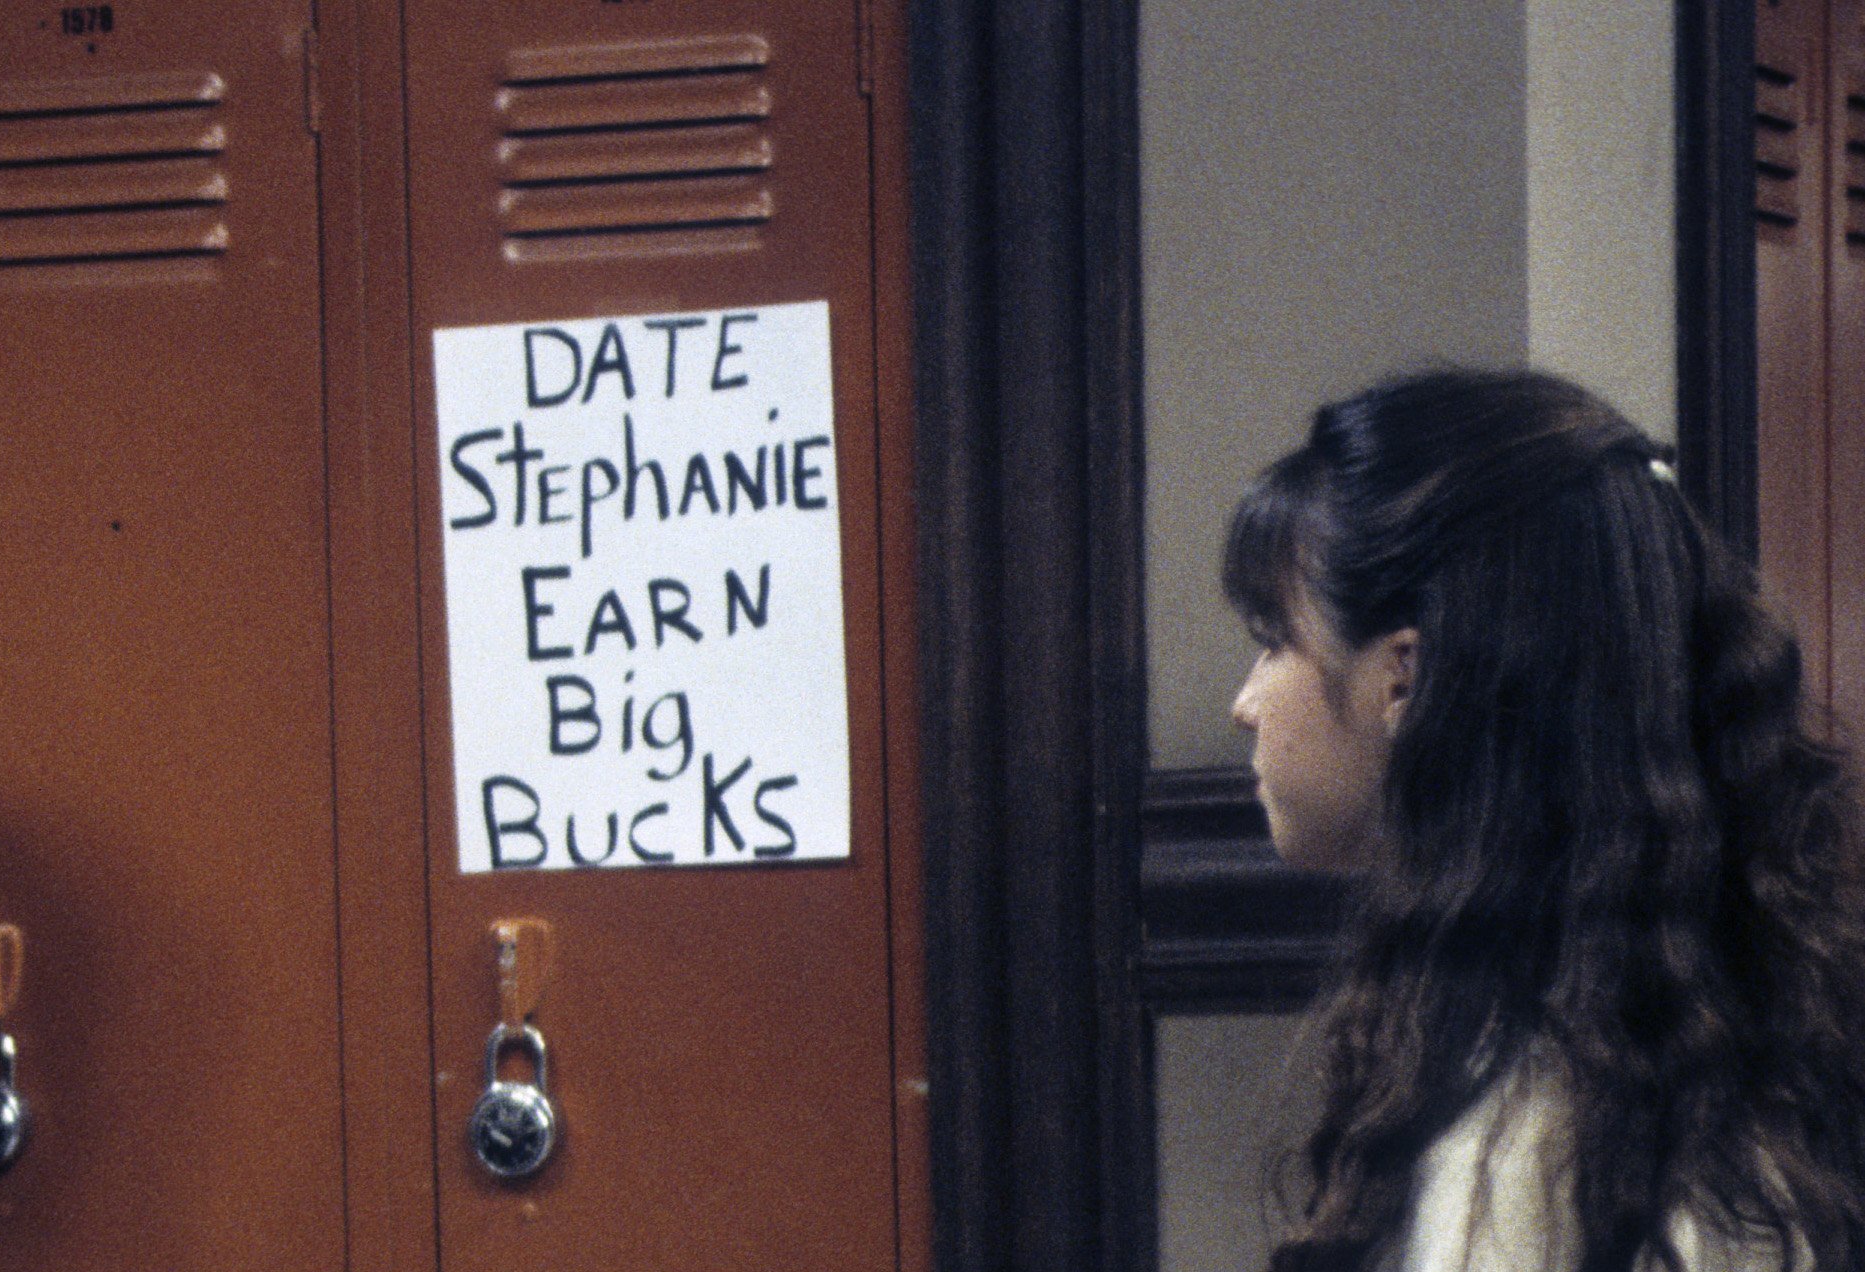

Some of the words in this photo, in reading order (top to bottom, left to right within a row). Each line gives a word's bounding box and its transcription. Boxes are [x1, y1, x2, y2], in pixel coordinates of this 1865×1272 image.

[523, 313, 758, 408] DATE
[521, 562, 771, 661] EARN
[546, 670, 695, 780] Big
